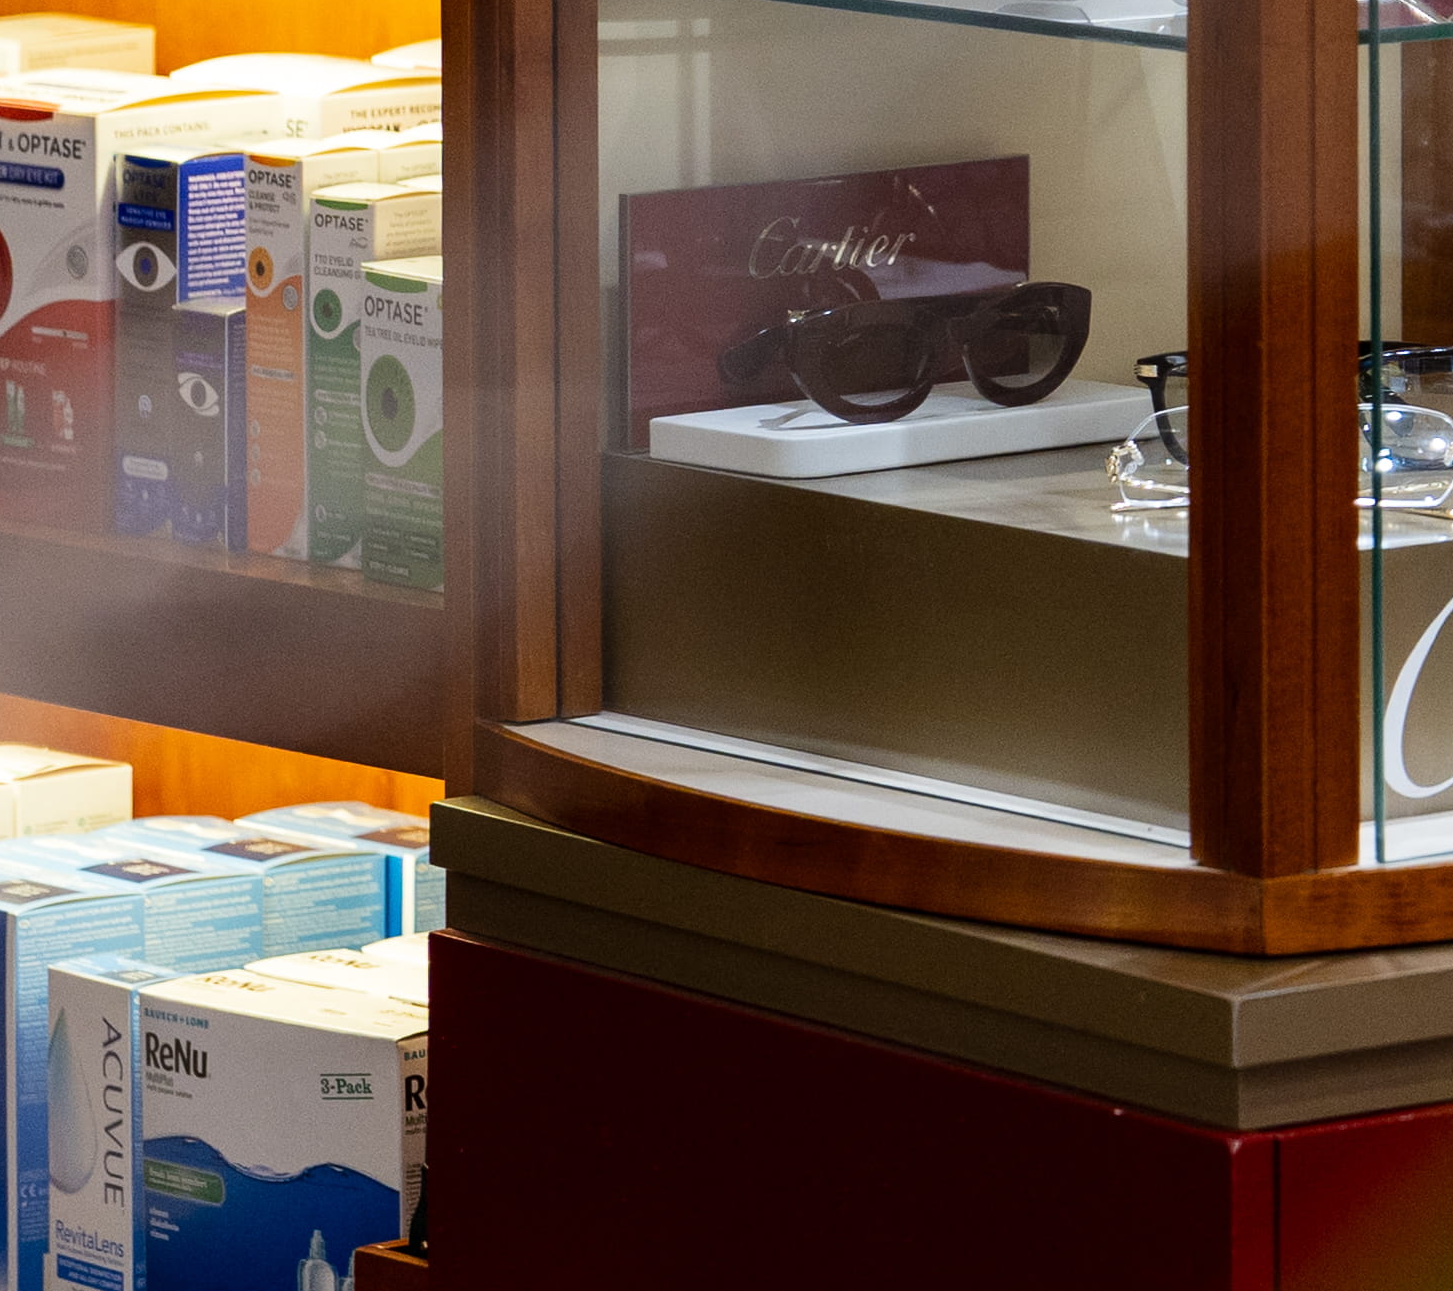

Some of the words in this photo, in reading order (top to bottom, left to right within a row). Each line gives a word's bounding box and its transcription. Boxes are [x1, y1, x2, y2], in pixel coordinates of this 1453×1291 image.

[17, 132, 84, 160] OPTASE
[249, 169, 292, 189] OPTASE
[315, 213, 364, 233] OPTASE
[747, 214, 916, 281] Cartier
[364, 295, 425, 326] OPTASE
[145, 1031, 208, 1078] ReNu
[320, 1077, 373, 1095] 3-Pack
[102, 1016, 125, 1208] ACUVUE
[55, 1219, 124, 1258] RevitaLens
